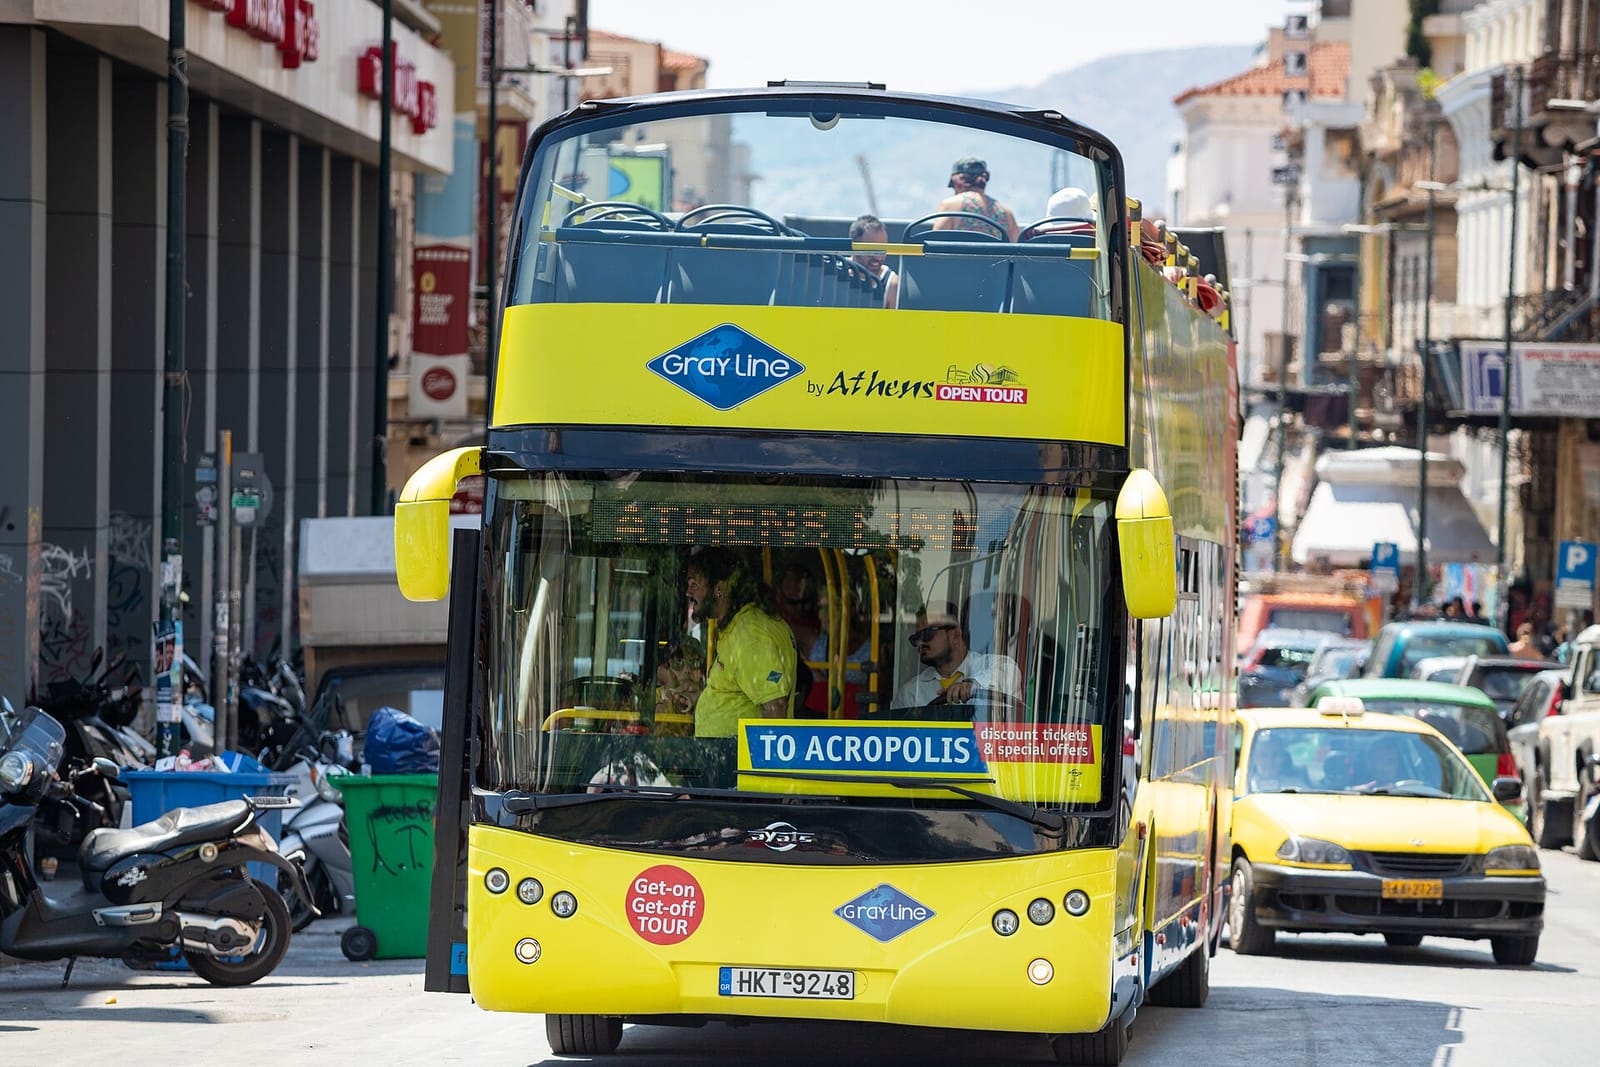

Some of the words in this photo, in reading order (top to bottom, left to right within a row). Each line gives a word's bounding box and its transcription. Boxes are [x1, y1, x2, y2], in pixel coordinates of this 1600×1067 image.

[735, 353, 790, 377] Line
[807, 379, 825, 396] by
[826, 369, 935, 399] Athens
[939, 386, 982, 401] OPEN
[985, 387, 1025, 403] TOUR
[613, 504, 830, 546] ATHENS
[854, 511, 980, 550] LINE
[1566, 544, 1589, 572] P
[980, 727, 1039, 741] discount
[1042, 728, 1088, 742] tickets
[759, 734, 797, 762] TO
[804, 735, 971, 764] ACROPOLIS
[983, 742, 994, 755] &
[997, 742, 1045, 758] special
[1049, 744, 1089, 757] offers
[634, 878, 696, 898] Get-on
[631, 897, 697, 917] Get-off
[890, 903, 927, 921] Line
[637, 916, 688, 935] TOUR
[720, 983, 731, 991] GR
